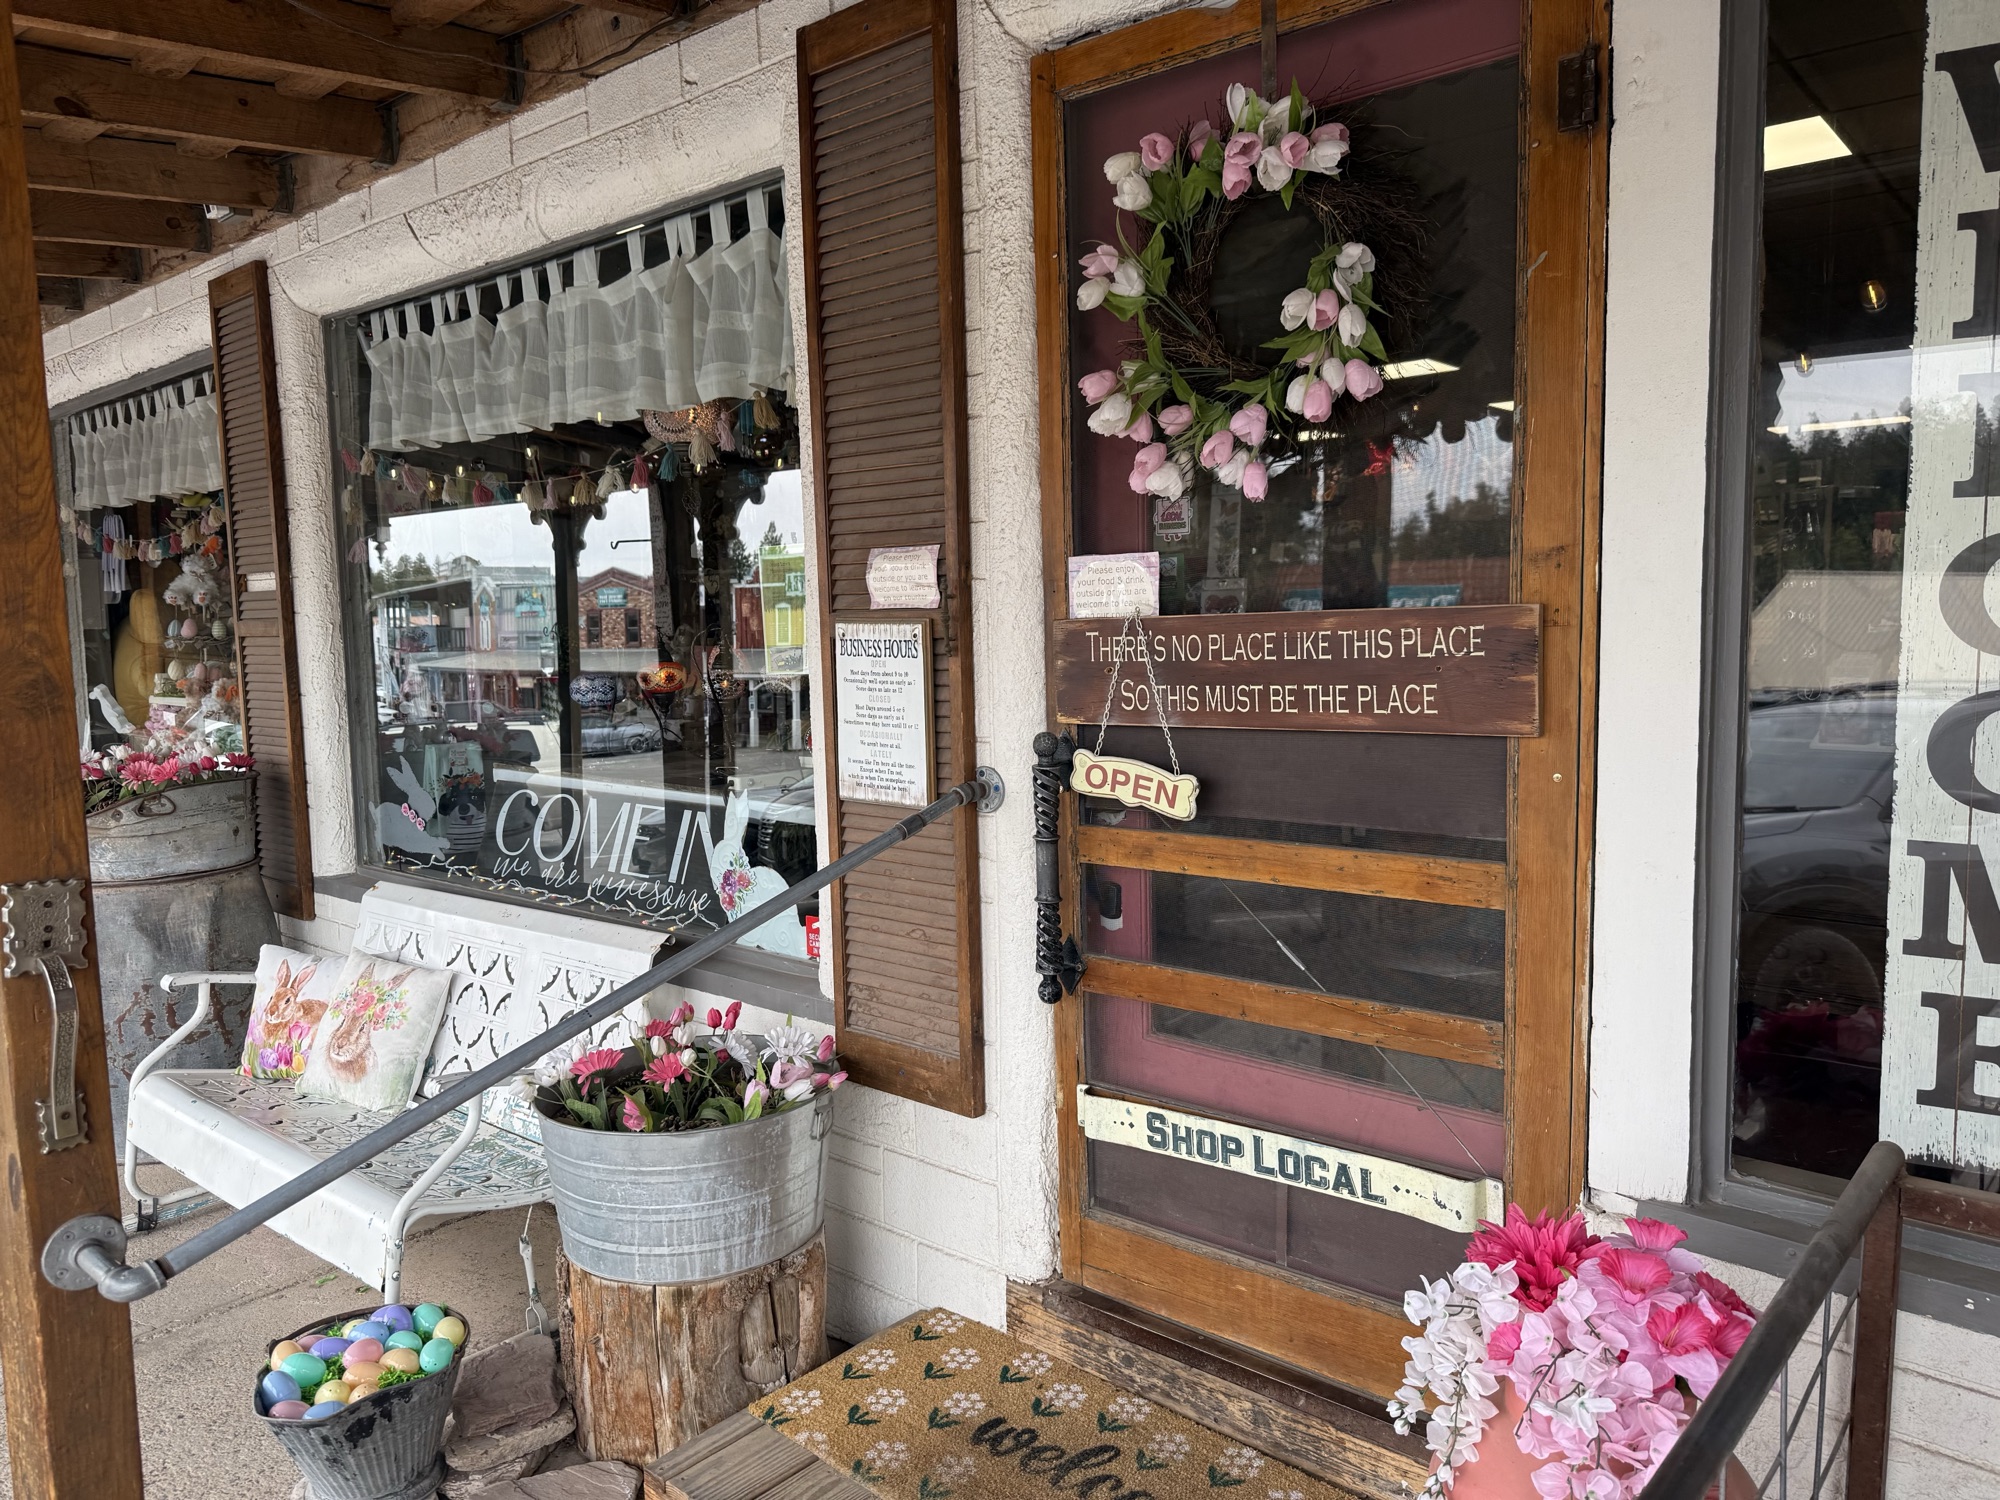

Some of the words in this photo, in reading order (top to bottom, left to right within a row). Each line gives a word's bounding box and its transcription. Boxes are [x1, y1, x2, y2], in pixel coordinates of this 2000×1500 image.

[904, 553, 921, 561] enjoy
[1087, 566, 1113, 575] Please
[1115, 565, 1136, 574] enjoy
[873, 575, 895, 583] outside
[1077, 579, 1095, 588] your
[1098, 576, 1115, 585] food
[1125, 575, 1145, 584] drink
[1076, 589, 1104, 598] outside
[1117, 589, 1132, 597] you
[1076, 600, 1109, 608] welcome
[840, 639, 882, 658] BUSINESS
[884, 639, 918, 658] HOURS
[1086, 631, 1167, 663] THERE'S
[1171, 634, 1202, 662] NO
[1208, 632, 1277, 662] PLACE
[1283, 631, 1332, 661] LIKE
[1337, 628, 1393, 660] THIS
[1400, 625, 1485, 659] PLACE
[871, 660, 886, 668] OPEN
[860, 669, 869, 677] days
[867, 685, 877, 693] days
[869, 694, 891, 703] CLOSED
[1120, 679, 1150, 711] SO
[1154, 684, 1199, 713] THIS
[1205, 684, 1265, 714] MUST
[1270, 684, 1299, 713] BE
[1303, 684, 1349, 714] THE
[1357, 684, 1438, 715] PLACE
[866, 704, 876, 712] Days
[867, 712, 877, 720] days
[871, 720, 880, 728] stay
[860, 729, 903, 741] OCCASIONALLY
[870, 749, 893, 759] LATELY
[1084, 763, 1180, 810] OPEN
[495, 789, 665, 878] COME
[668, 809, 718, 890] IN
[493, 856, 532, 877] we
[541, 861, 580, 888] are
[591, 874, 712, 912] awesome
[1146, 1111, 1244, 1166] SHOP
[1253, 1135, 1387, 1206] LOCAL
